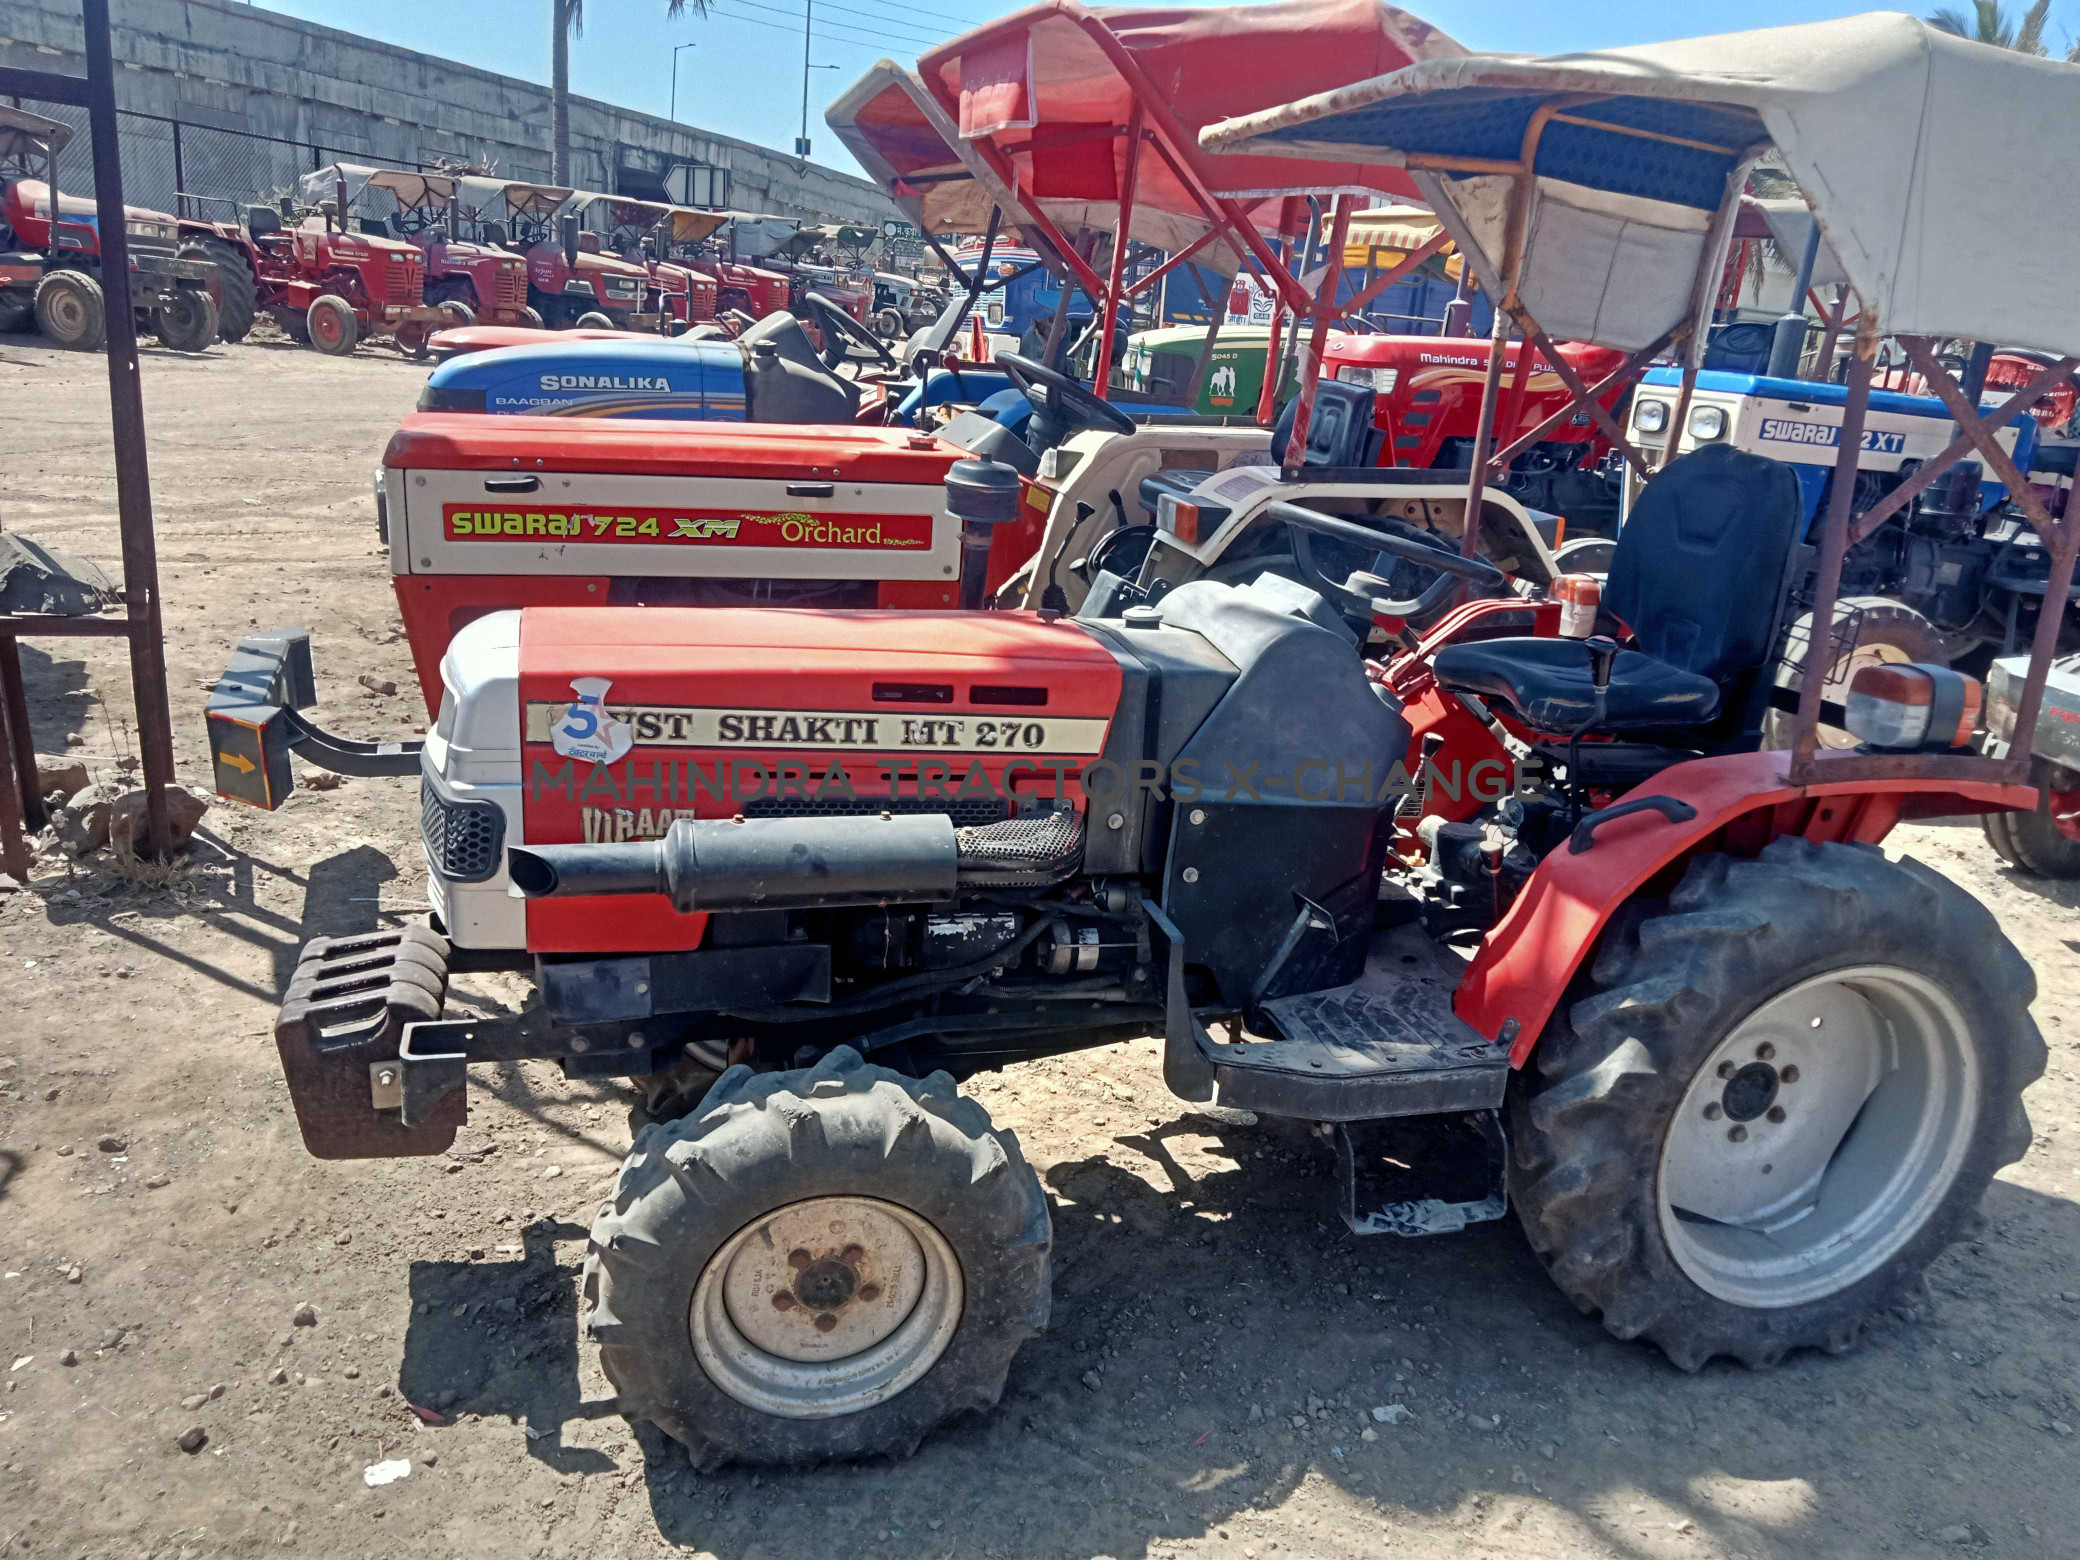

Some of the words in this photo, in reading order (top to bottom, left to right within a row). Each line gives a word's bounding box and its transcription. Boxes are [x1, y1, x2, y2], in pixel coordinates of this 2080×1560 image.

[1420, 353, 1478, 366] Mahindra
[540, 375, 672, 393] SONALIKA
[495, 397, 573, 406] BAAGBAN
[1873, 432, 1904, 452] XT
[594, 516, 660, 537] 724
[666, 518, 742, 539] XM
[781, 520, 880, 544] Orchard
[717, 713, 880, 746] SHAKTI
[901, 718, 965, 746] MT
[976, 721, 1046, 748] 270
